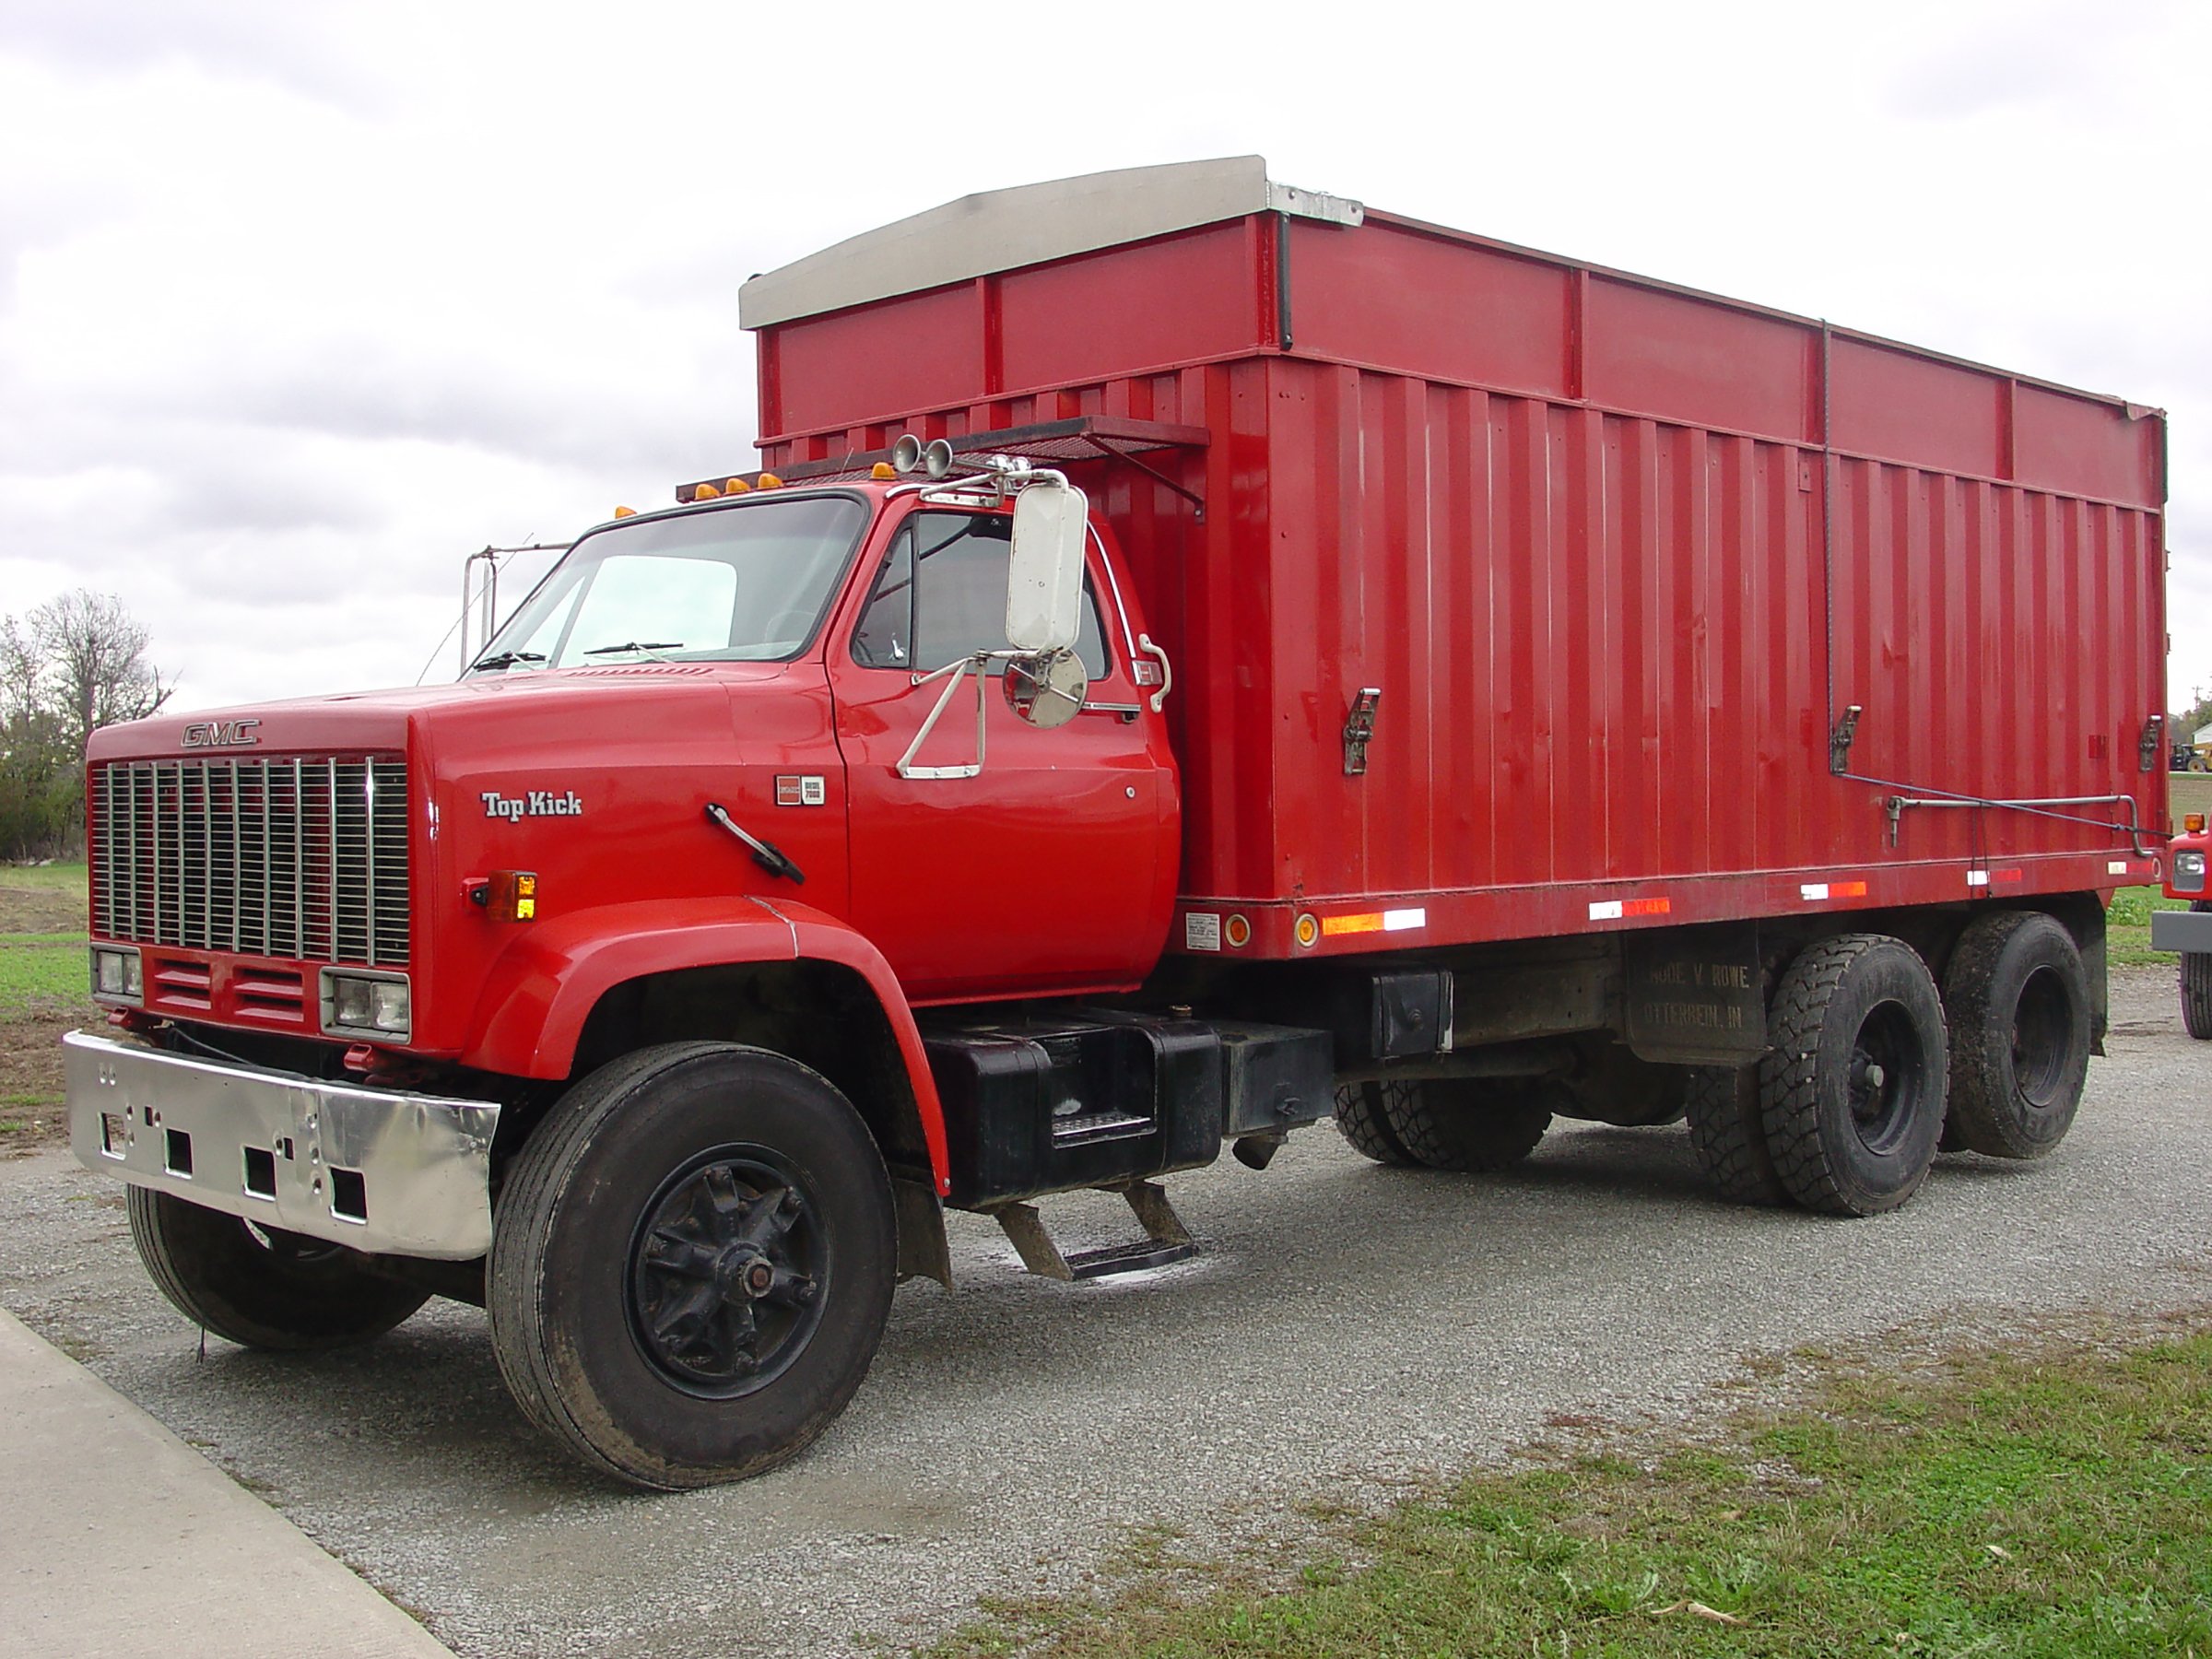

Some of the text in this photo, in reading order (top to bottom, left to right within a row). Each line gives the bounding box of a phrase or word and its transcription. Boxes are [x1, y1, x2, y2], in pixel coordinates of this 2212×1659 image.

[181, 720, 259, 747] GMC
[1712, 964, 1749, 989] ROWE
[1727, 1006, 1743, 1029] IN
